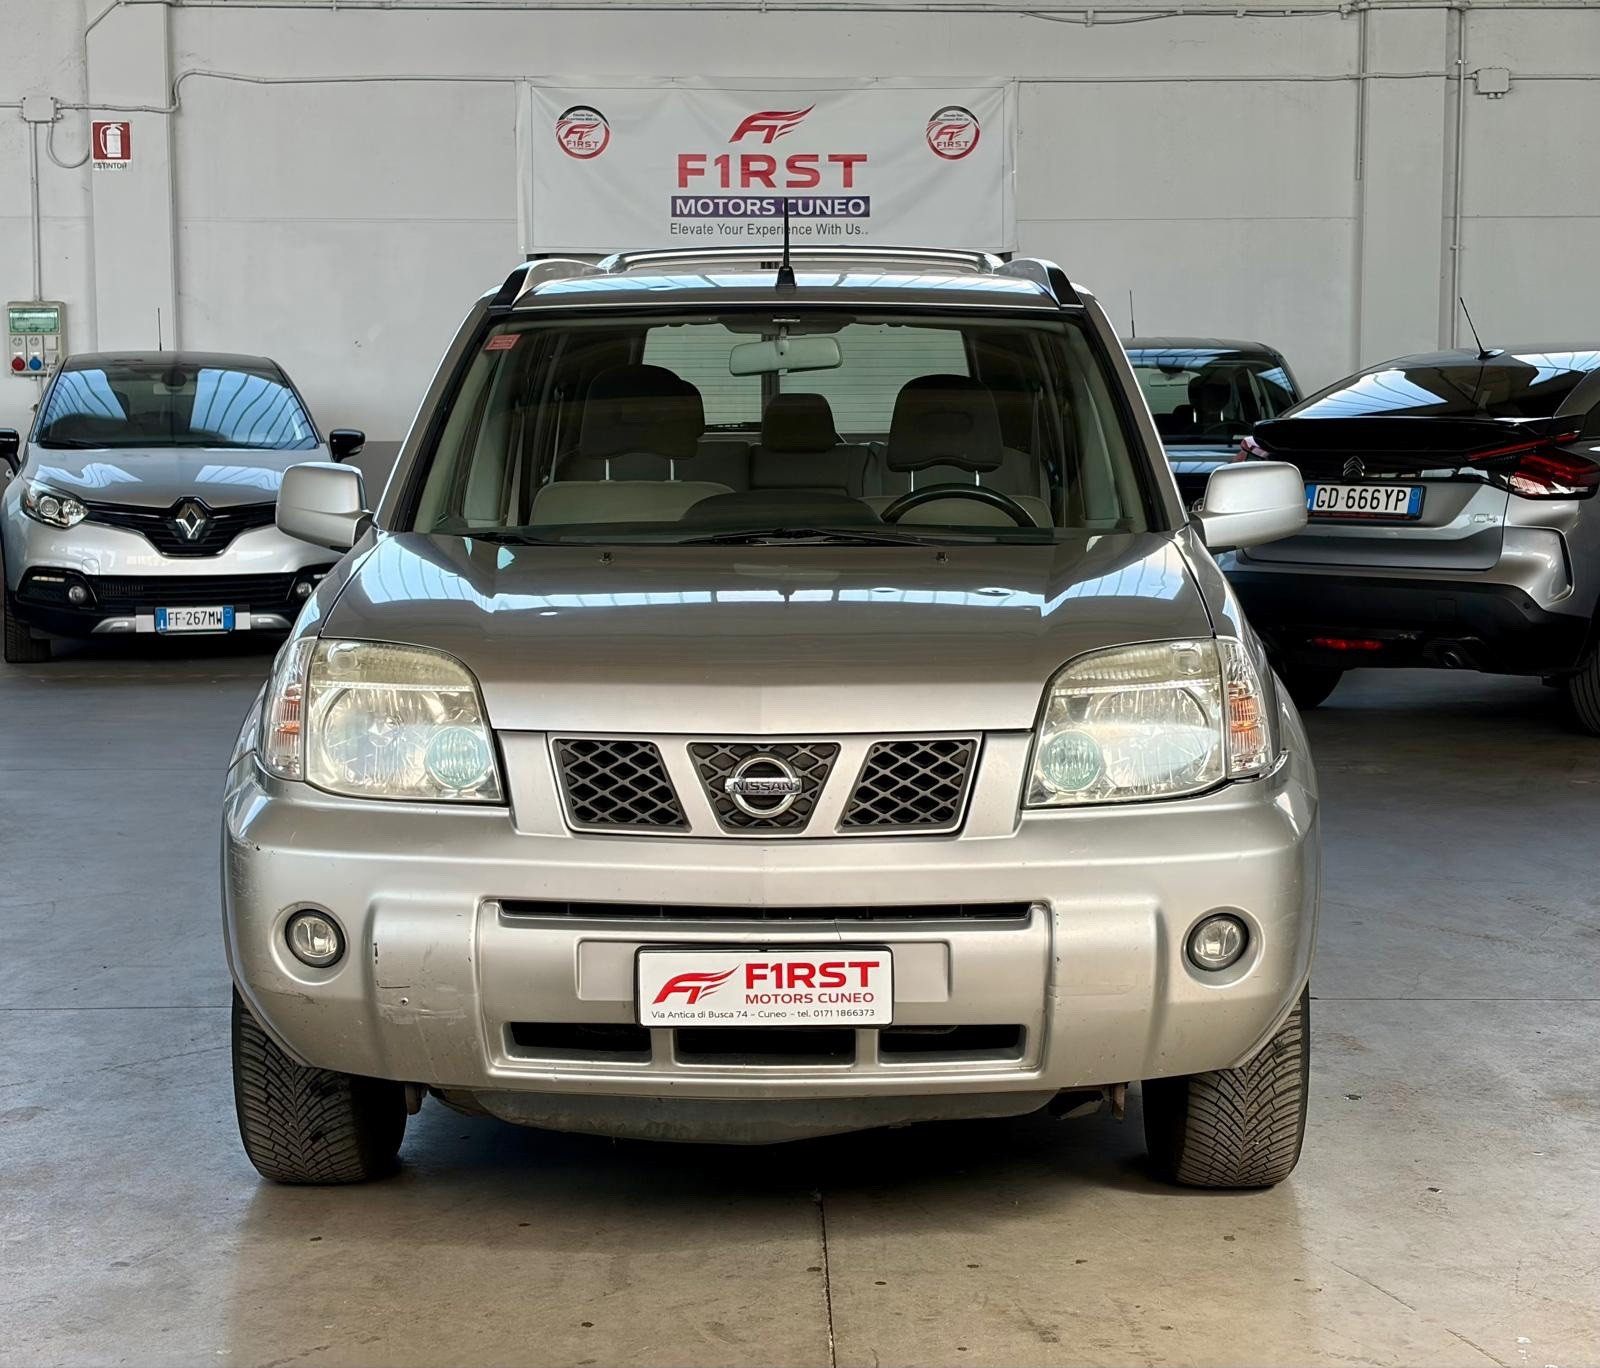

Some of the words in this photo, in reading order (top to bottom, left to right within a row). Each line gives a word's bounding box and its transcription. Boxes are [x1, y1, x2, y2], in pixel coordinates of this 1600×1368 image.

[567, 140, 599, 148] F1RST
[678, 154, 867, 188] F1RST
[676, 199, 776, 215] MOTORS
[782, 199, 865, 215] CUNEO
[670, 223, 713, 235] Elevate
[717, 223, 744, 235] Your
[747, 223, 812, 237] Experince
[816, 223, 842, 235] With
[733, 781, 794, 791] NISSAN
[746, 961, 880, 989] F1RST
[745, 993, 813, 1004] MOTORS
[818, 992, 875, 1003] CUNEO
[651, 1011, 666, 1019] Via
[758, 1010, 787, 1018] Cuneo
[813, 1009, 833, 1017] 0171
[836, 1009, 875, 1017] 1866373
